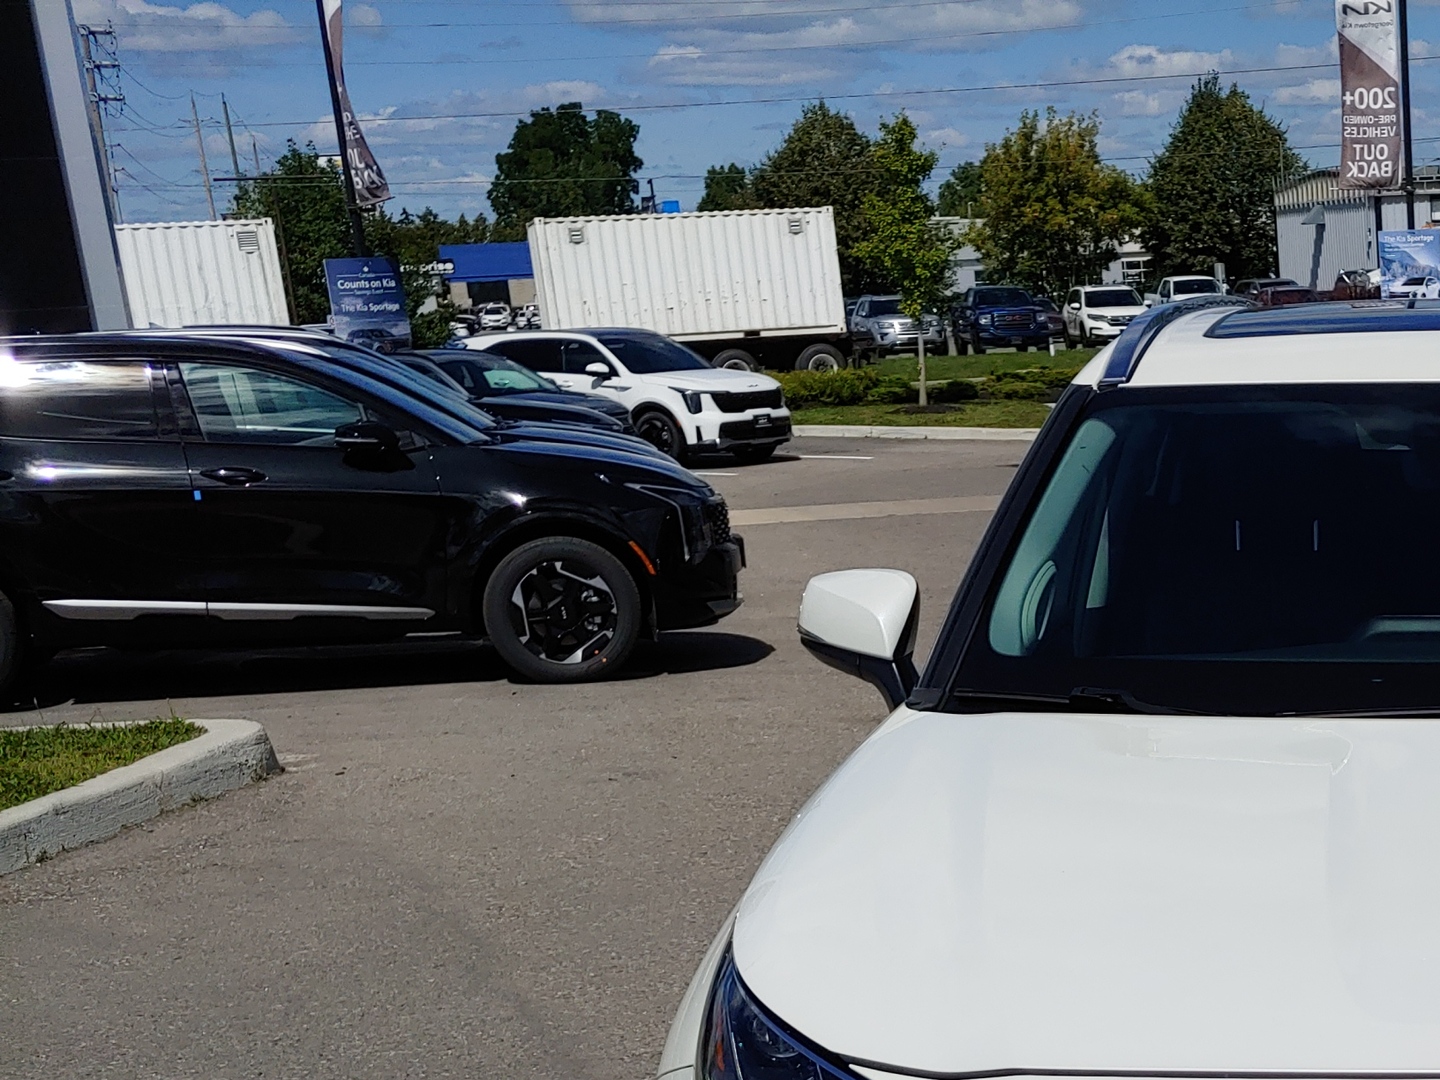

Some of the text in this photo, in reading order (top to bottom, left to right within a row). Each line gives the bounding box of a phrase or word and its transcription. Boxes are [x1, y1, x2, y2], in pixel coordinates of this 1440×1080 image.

[1407, 234, 1434, 243] Sportage
[337, 280, 370, 289] Counts
[382, 278, 396, 288] Kia
[341, 302, 400, 313] The Kia Sportage
